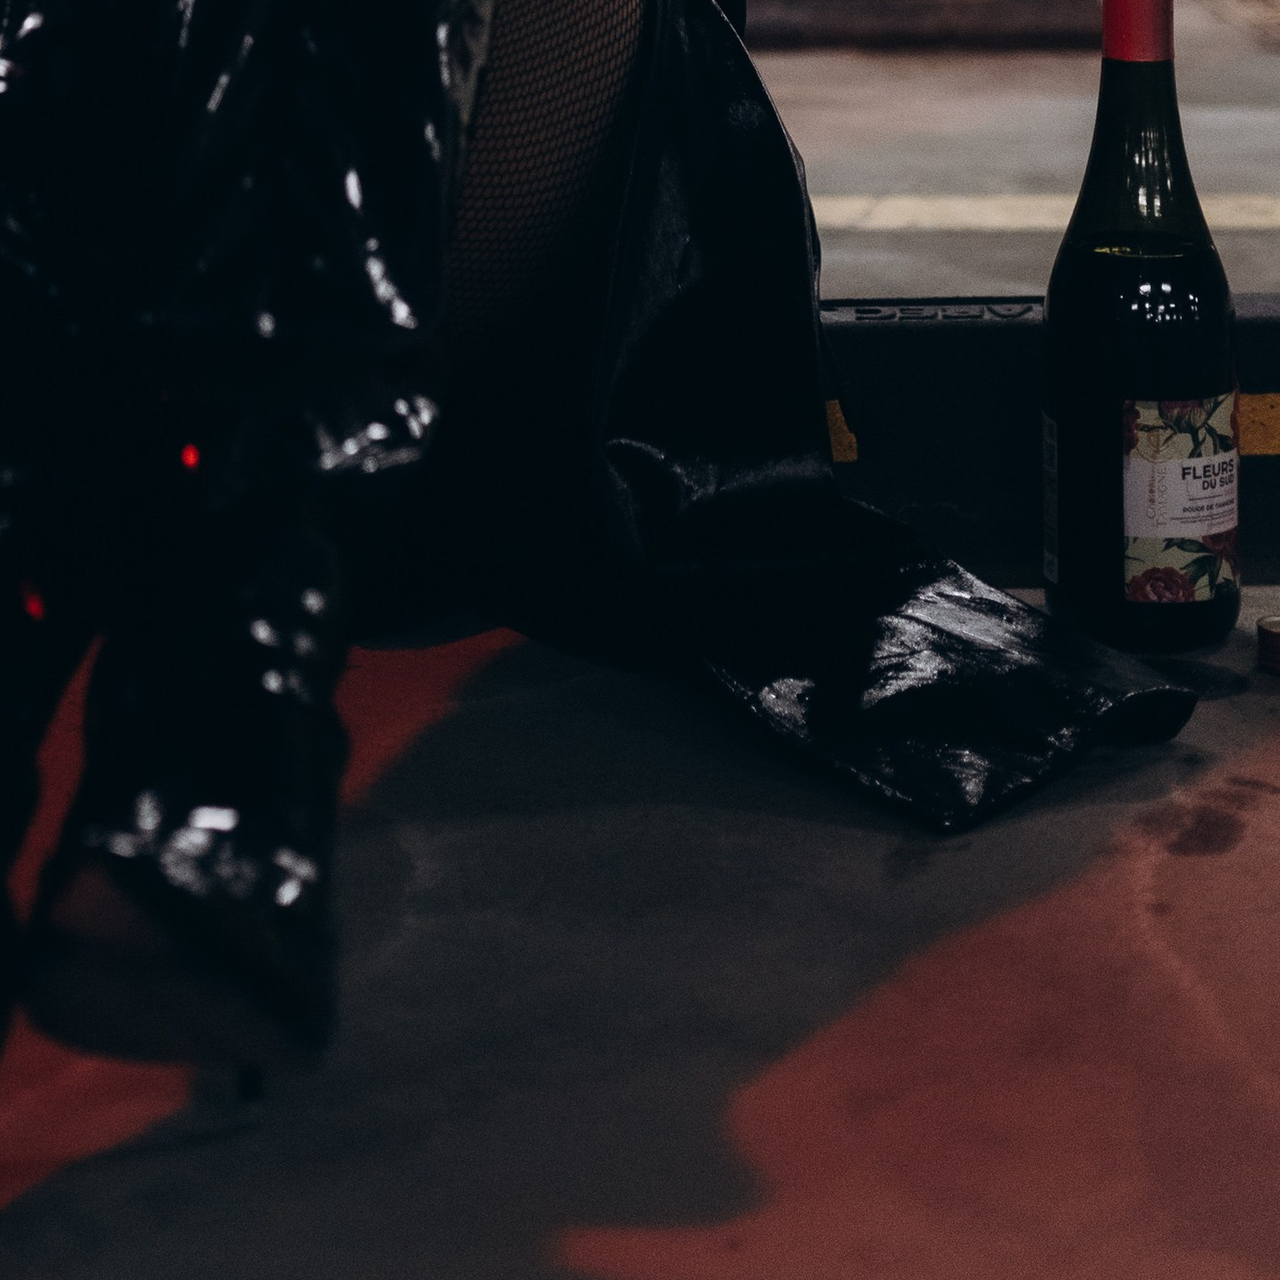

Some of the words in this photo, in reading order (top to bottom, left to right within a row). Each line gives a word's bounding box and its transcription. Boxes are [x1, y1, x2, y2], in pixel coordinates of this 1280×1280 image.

[1182, 459, 1234, 480] FLEURS
[1202, 479, 1217, 490] DU
[1219, 474, 1234, 487] SUD
